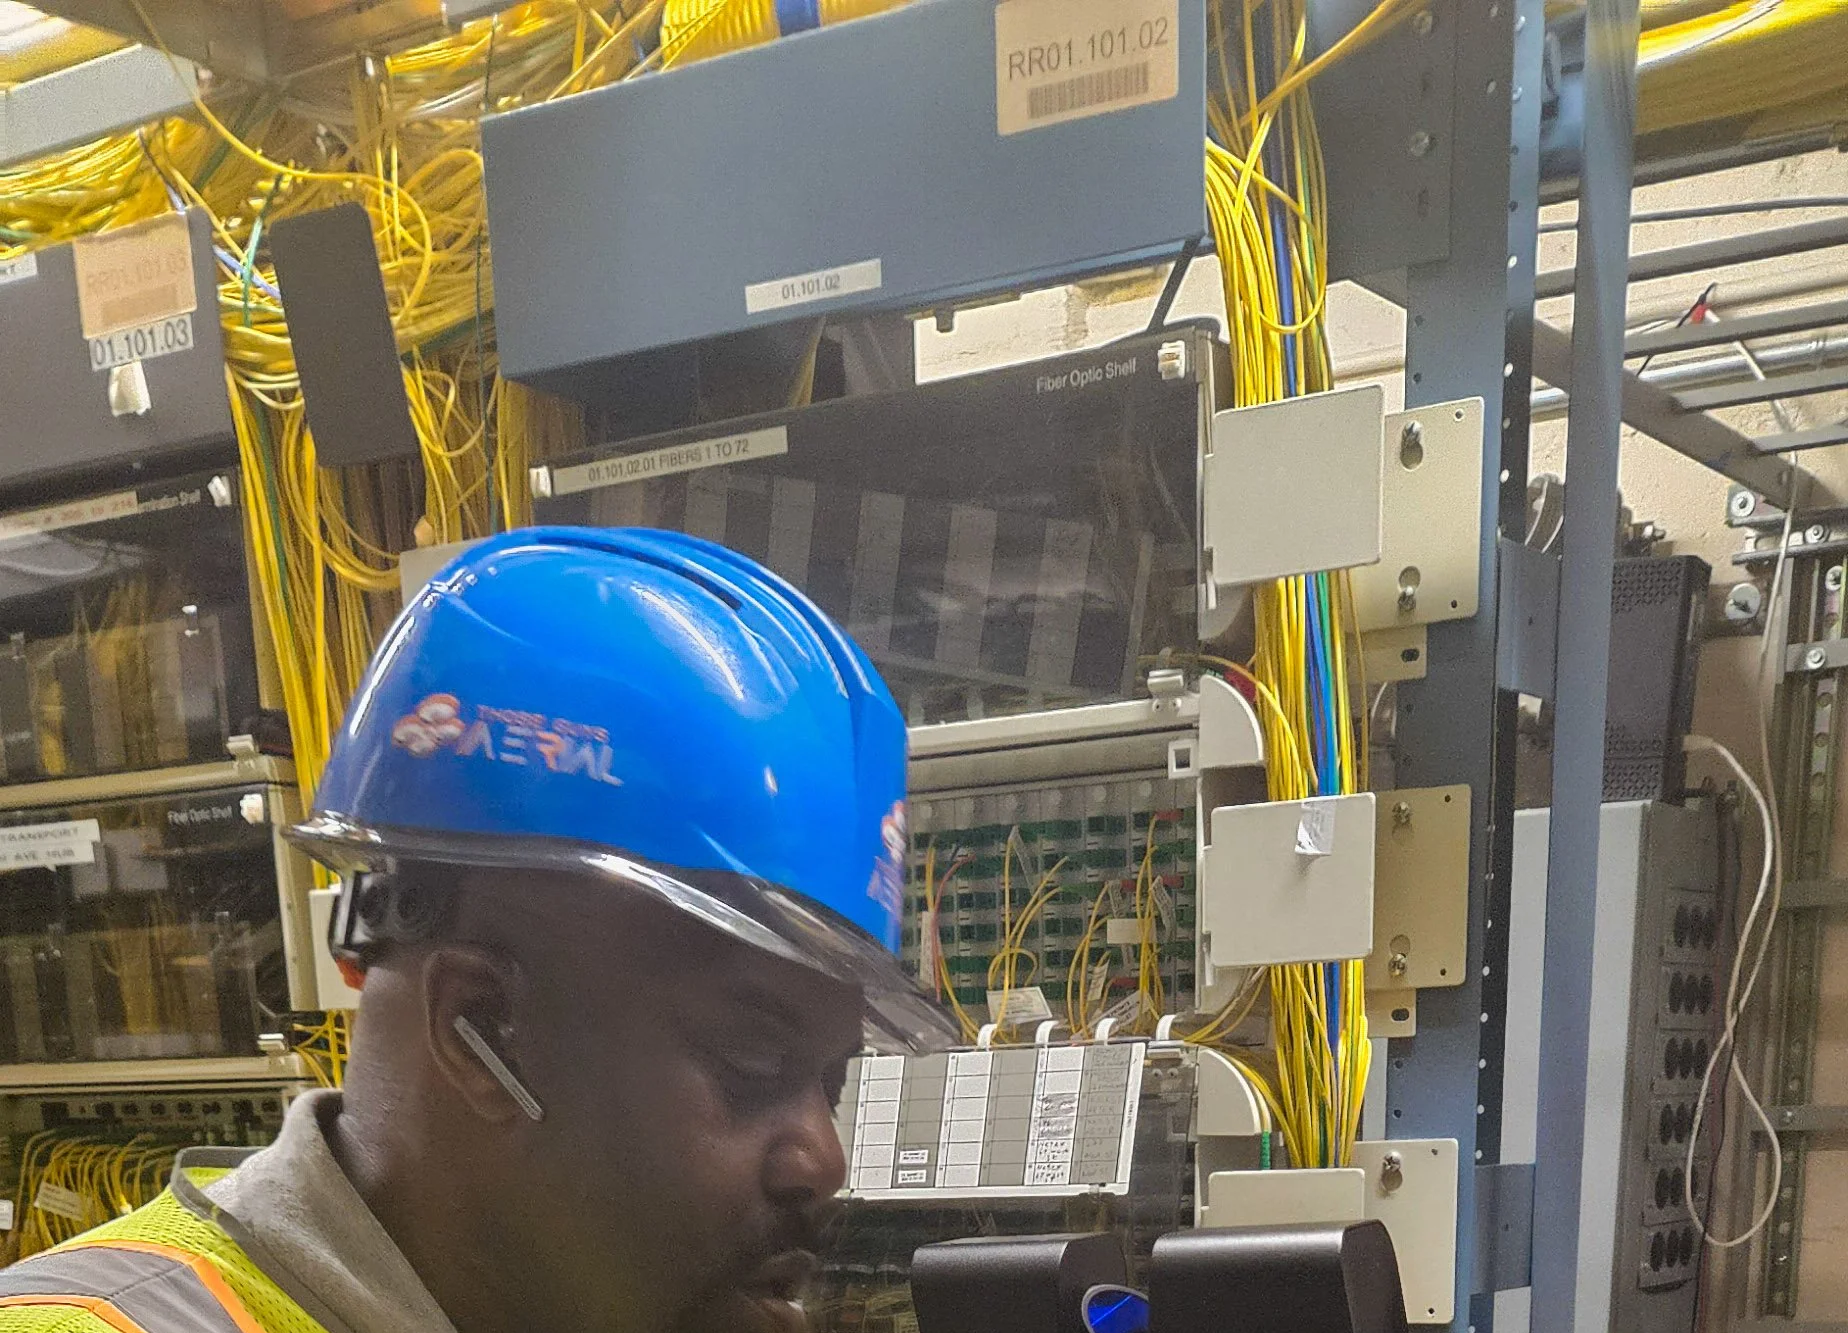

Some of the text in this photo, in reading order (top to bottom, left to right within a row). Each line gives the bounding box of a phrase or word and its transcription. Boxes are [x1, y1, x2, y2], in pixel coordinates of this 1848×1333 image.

[1008, 16, 1168, 81] RR01.101.02
[781, 273, 840, 299] 01.101.02
[93, 319, 191, 366] 01.101.03
[1036, 356, 1137, 394] Fiber Optic Shelf
[659, 448, 702, 470] FIBERS
[714, 442, 733, 458] TO
[734, 438, 749, 455] 72
